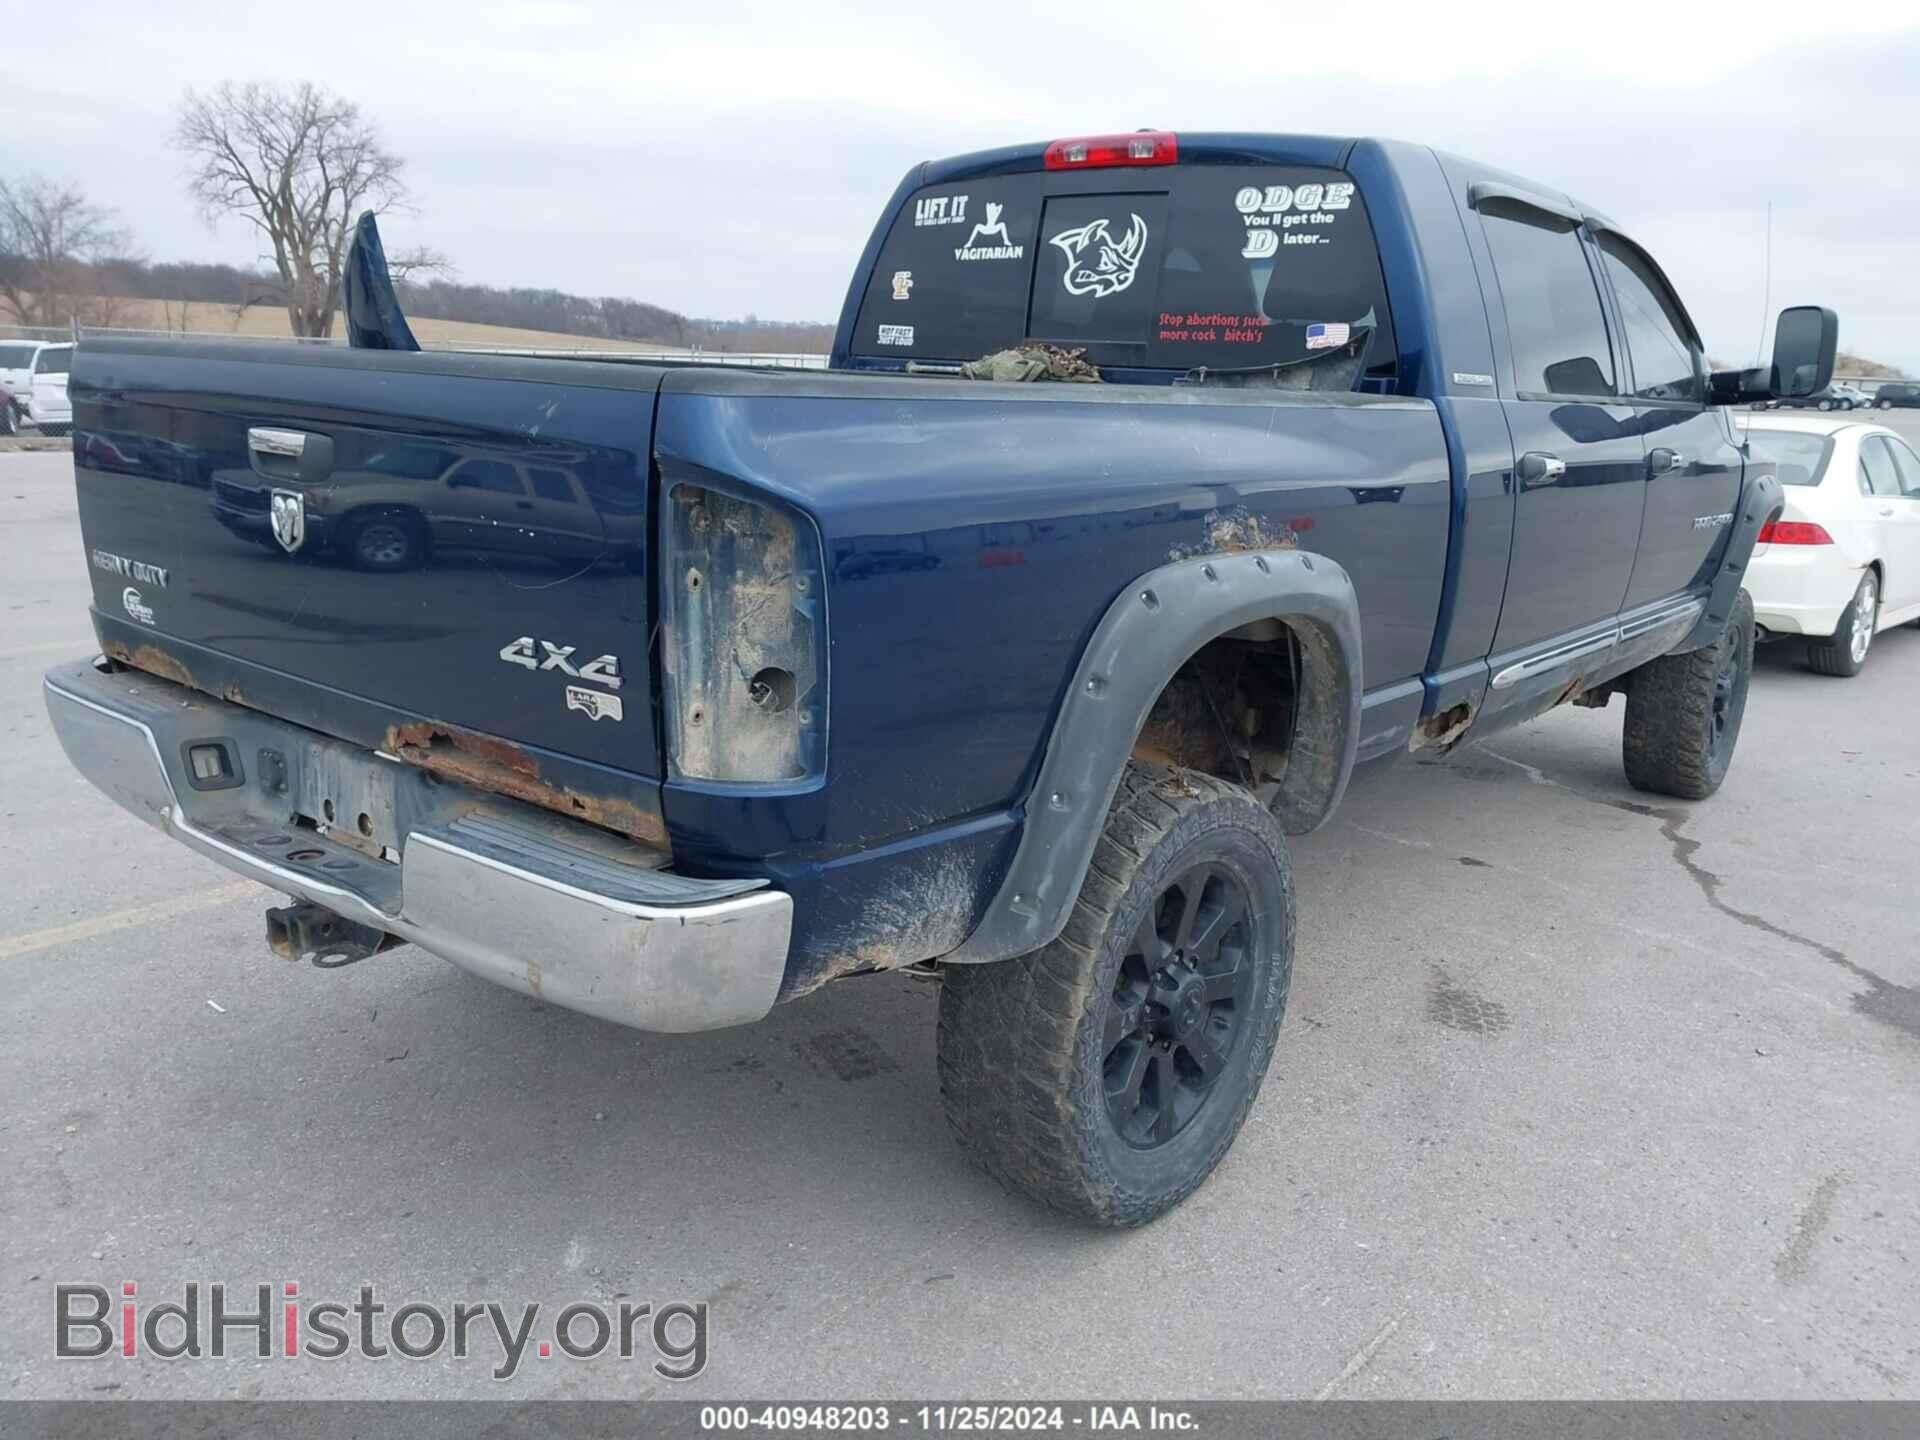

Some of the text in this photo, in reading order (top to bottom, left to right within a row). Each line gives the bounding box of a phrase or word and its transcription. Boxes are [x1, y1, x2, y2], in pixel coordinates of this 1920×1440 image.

[915, 195, 969, 219] LIFT IT
[1235, 182, 1355, 213] ODGE
[1243, 215, 1270, 226] You
[1282, 214, 1308, 228] get
[1310, 211, 1335, 224] the
[1241, 228, 1279, 258] D
[1159, 312, 1184, 327] Stop
[1186, 312, 1240, 326] abortions
[1159, 328, 1263, 342] more cock bitch's
[133, 561, 168, 588] DUTY
